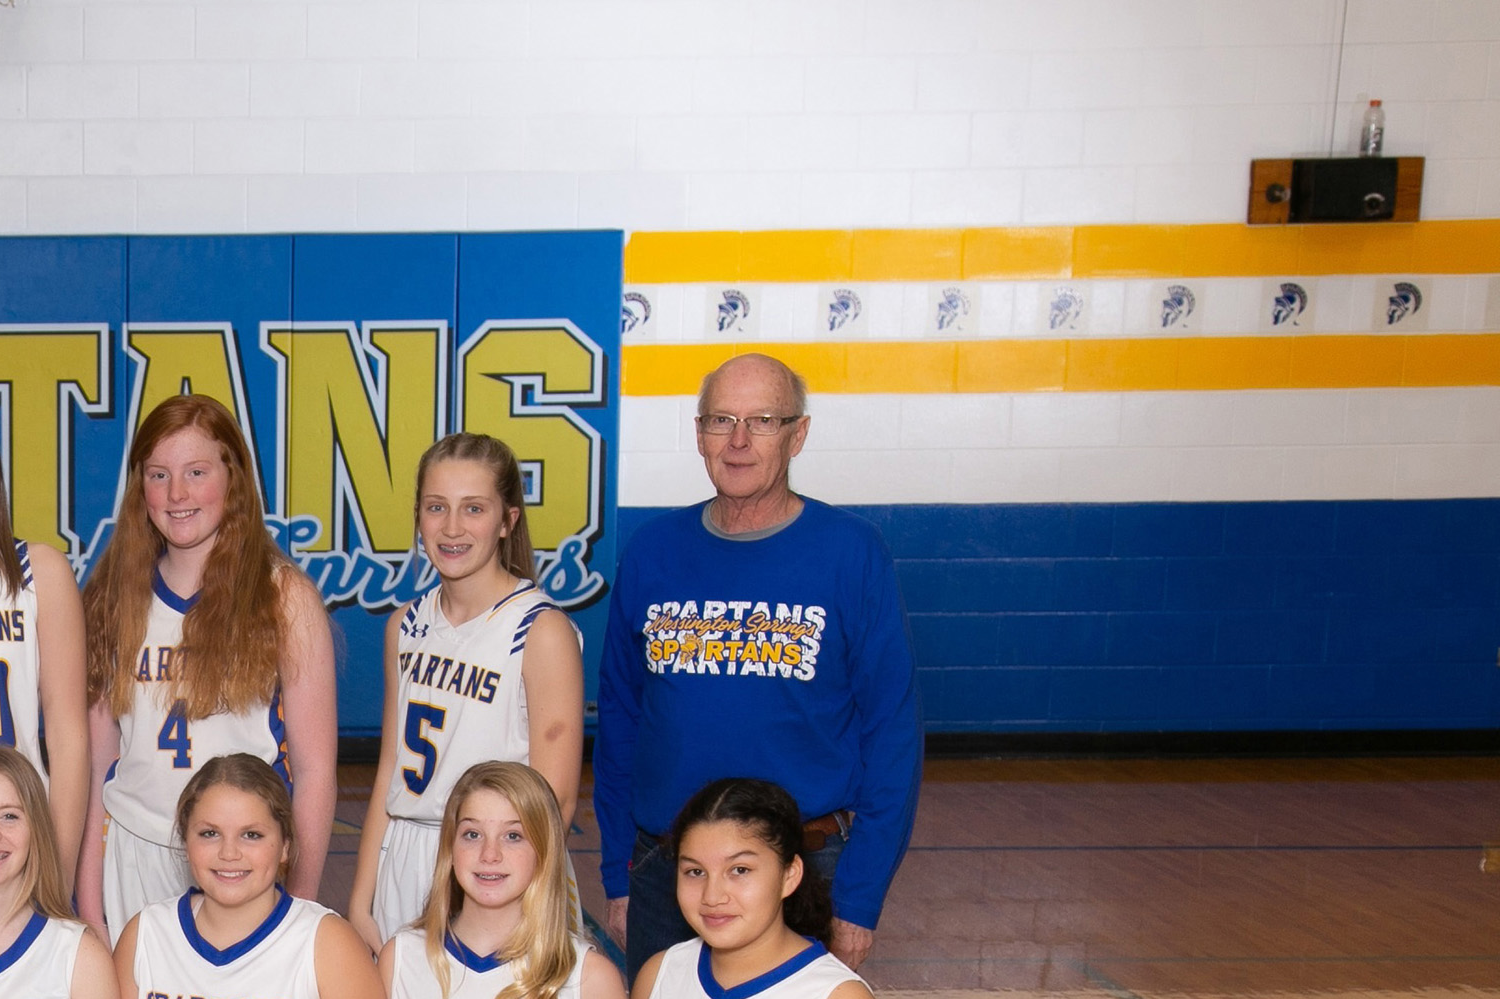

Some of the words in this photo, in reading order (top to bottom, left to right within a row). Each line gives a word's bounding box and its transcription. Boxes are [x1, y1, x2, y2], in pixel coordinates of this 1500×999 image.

[645, 610, 742, 637] Wessington
[743, 612, 817, 640] Springs
[157, 698, 194, 771] 4
[402, 699, 447, 798] 5
